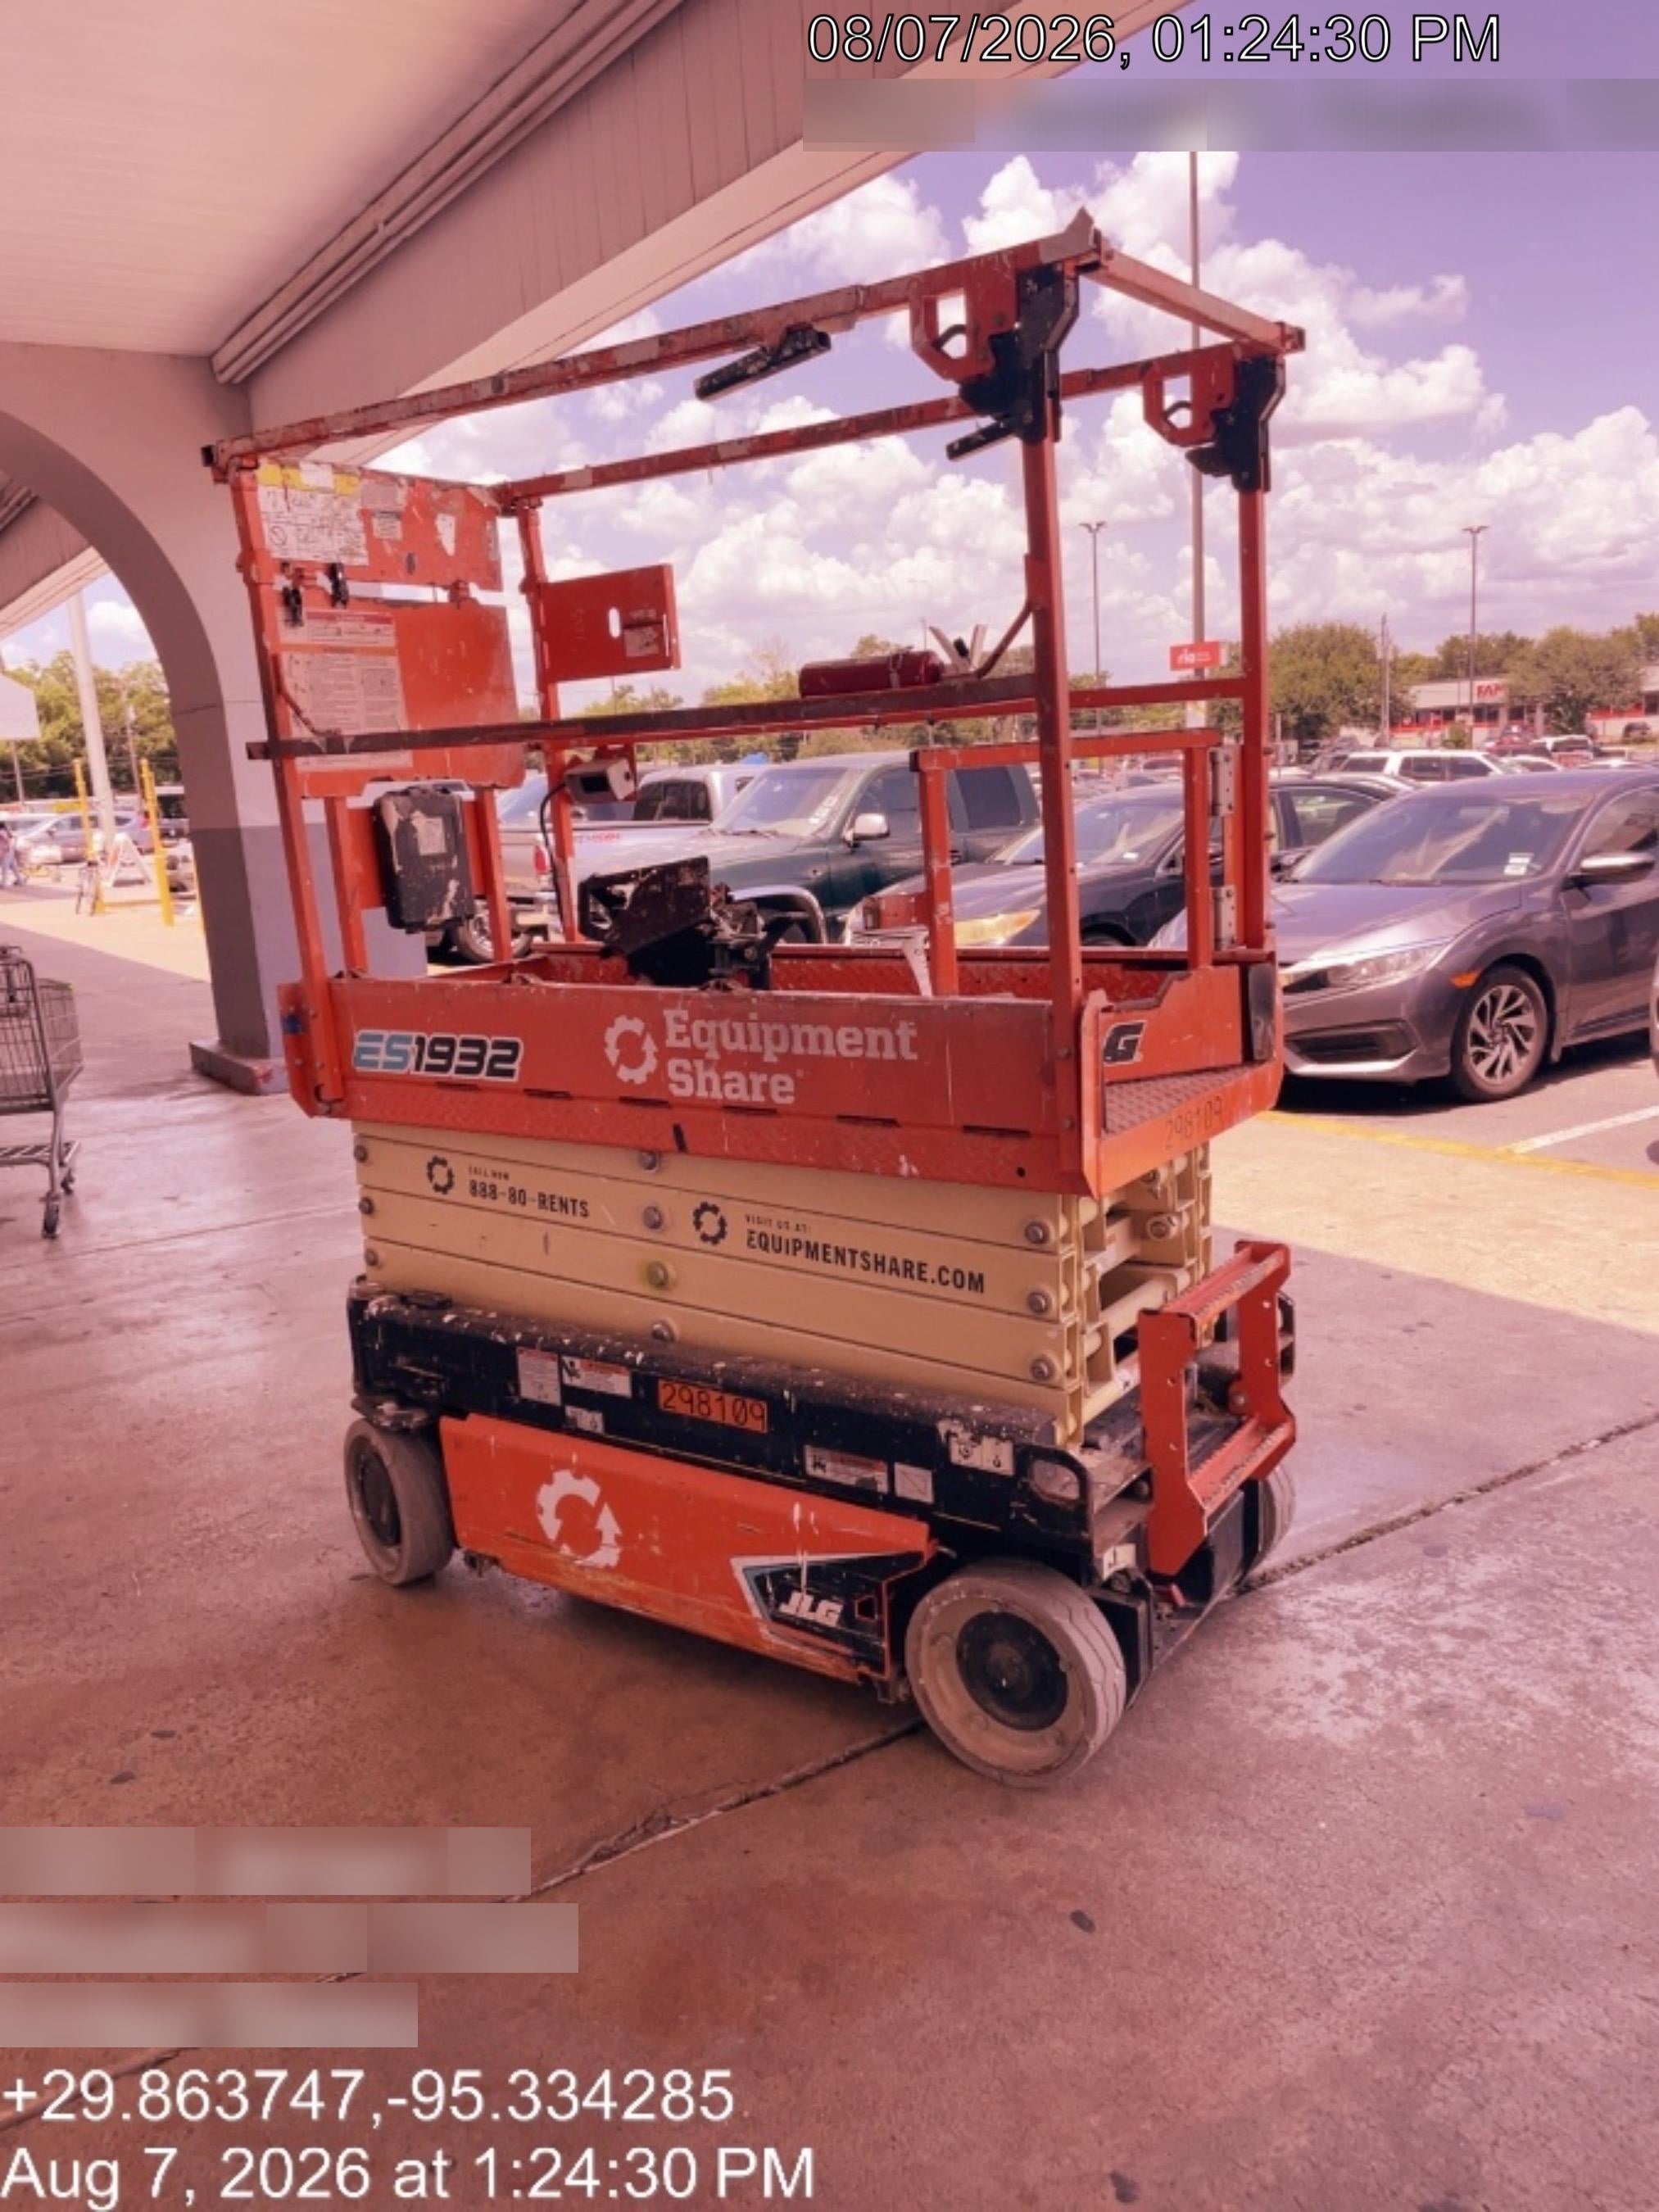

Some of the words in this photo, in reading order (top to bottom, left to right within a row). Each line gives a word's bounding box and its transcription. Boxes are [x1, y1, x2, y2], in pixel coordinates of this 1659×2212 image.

[353, 1030, 523, 1082] ES1932
[663, 1009, 918, 1063] Equipment
[667, 1058, 796, 1104] Share
[469, 1180, 590, 1217] 888-80-RENTS
[746, 1229, 985, 1294] EQUIPMENTSHARE.COM
[662, 1383, 765, 1431] 298109
[780, 1591, 844, 1628] JLG
